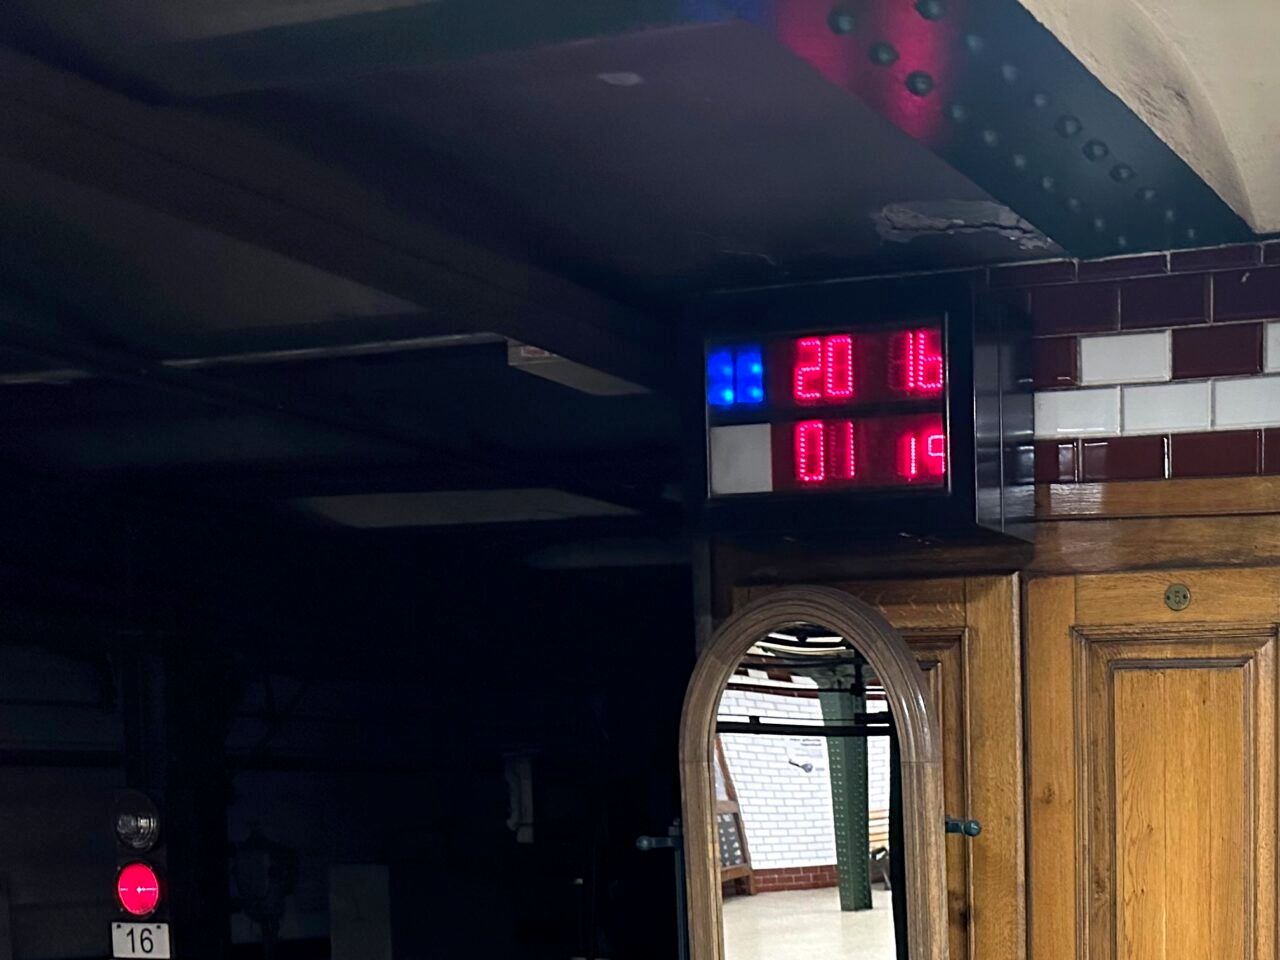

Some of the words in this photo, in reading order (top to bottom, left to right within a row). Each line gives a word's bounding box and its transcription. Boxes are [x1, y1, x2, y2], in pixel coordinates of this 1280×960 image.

[797, 337, 853, 399] 20
[798, 421, 855, 482] 01
[126, 928, 154, 954] 16
